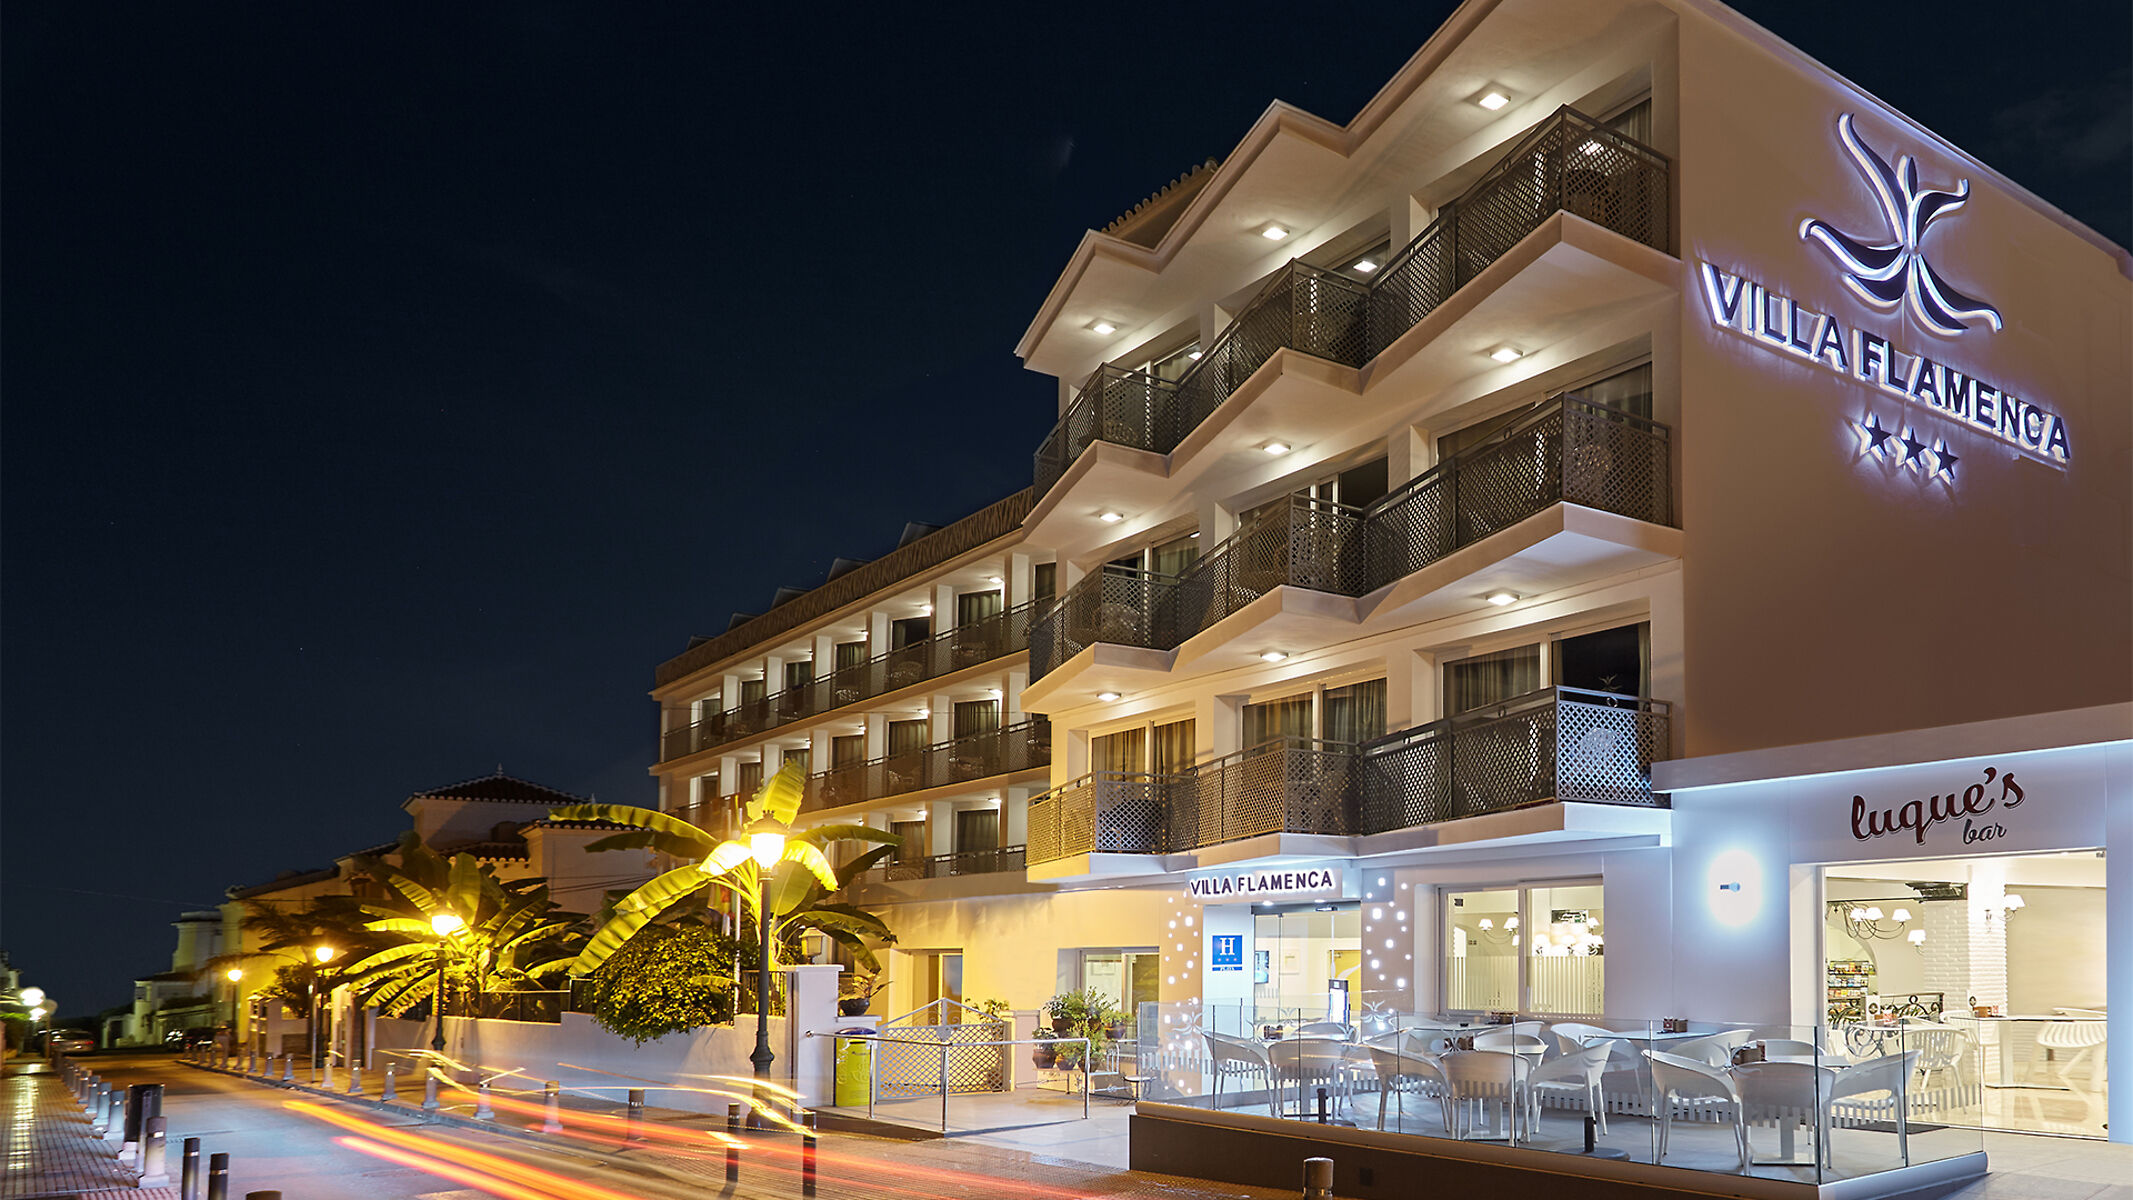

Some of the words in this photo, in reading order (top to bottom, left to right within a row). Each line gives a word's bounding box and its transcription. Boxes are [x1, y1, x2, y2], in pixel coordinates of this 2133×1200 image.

[1701, 261, 1848, 373] VILLA
[1853, 328, 2071, 463] FLAMENCA
[1851, 766, 2025, 845] luque's
[1962, 819, 2007, 845] bar
[1190, 878, 1232, 895] VILLA
[1237, 871, 1332, 892] FLAMENCA
[1219, 937, 1236, 956] H
